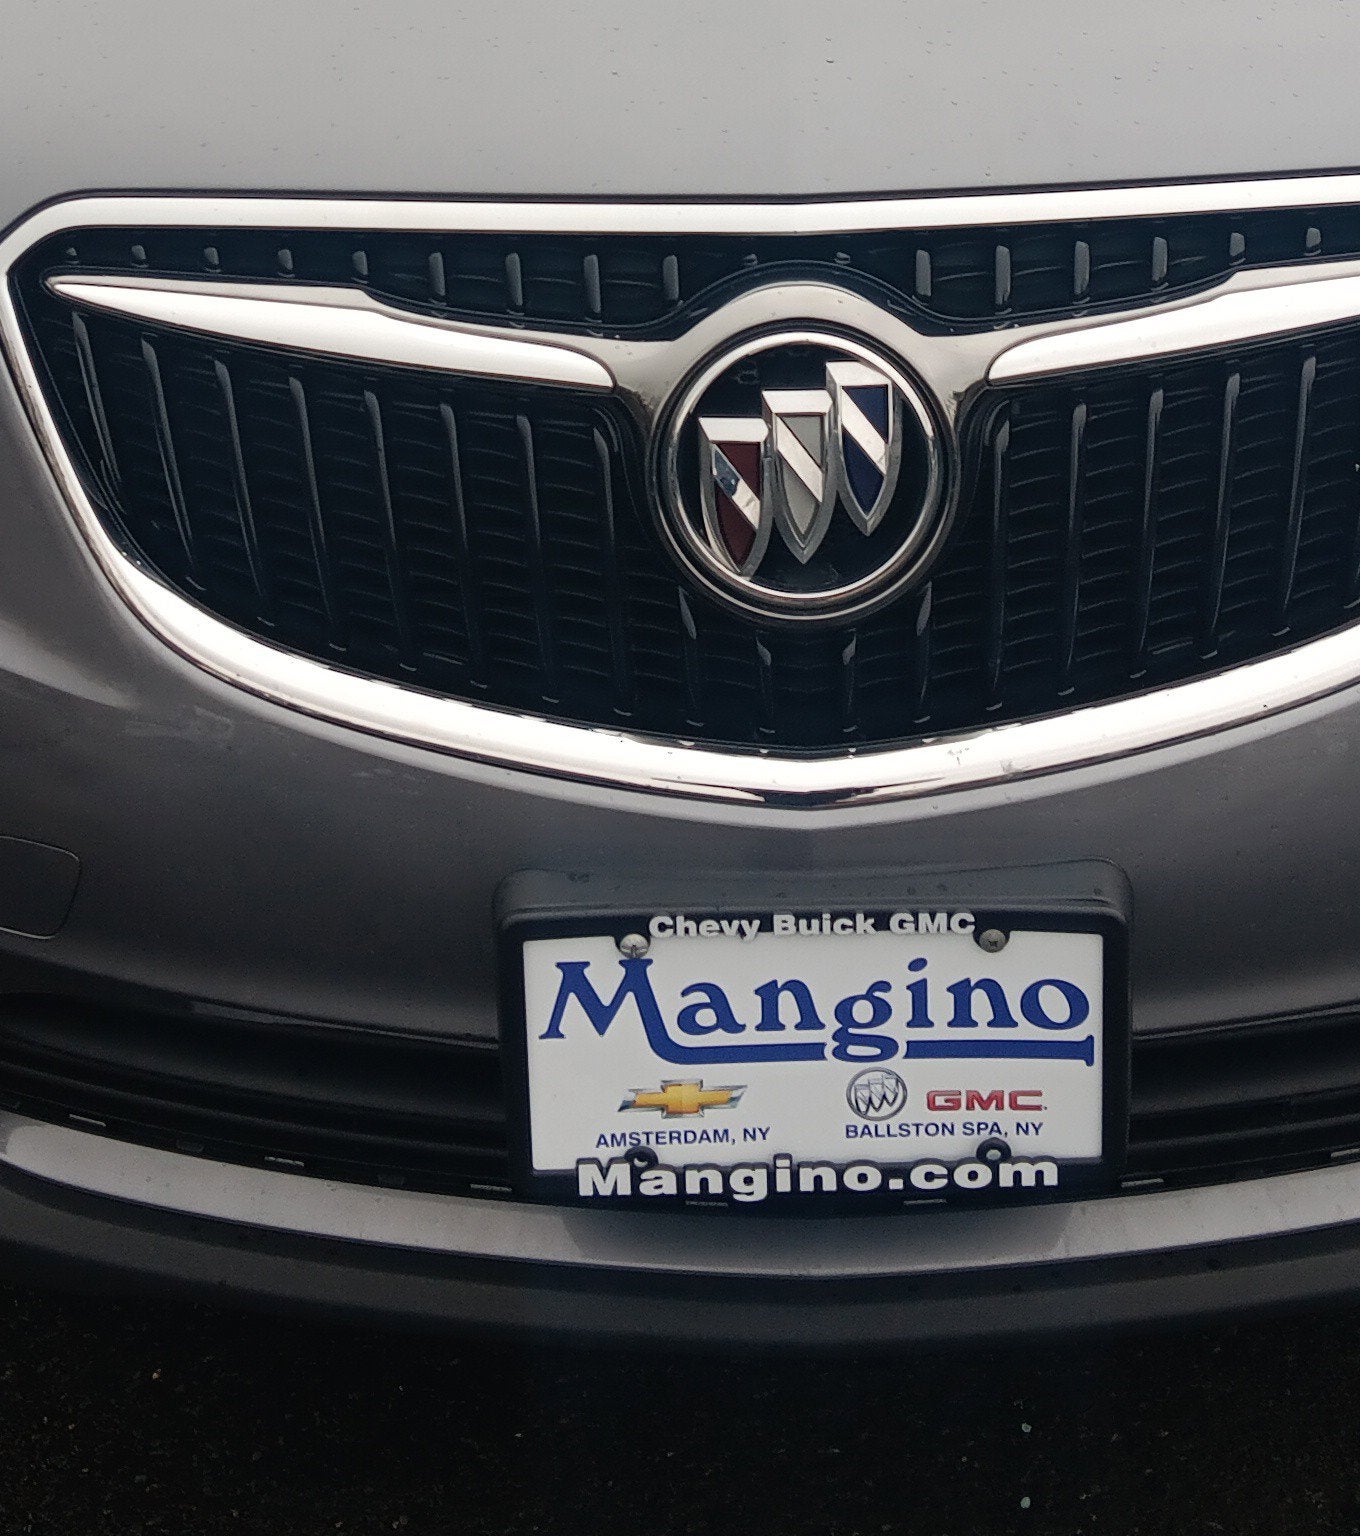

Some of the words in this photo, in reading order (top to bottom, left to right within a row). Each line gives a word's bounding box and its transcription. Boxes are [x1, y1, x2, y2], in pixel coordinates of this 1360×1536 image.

[648, 914, 761, 943] Chevy
[773, 913, 876, 936] Buick
[889, 912, 976, 936] GMC
[539, 958, 1095, 1066] Mangino
[926, 1090, 1044, 1111] GMC
[595, 1128, 737, 1148] AMSTERDAM,
[743, 1126, 771, 1142] NY
[845, 1122, 955, 1139] BALLSTON
[962, 1121, 1009, 1138] SPA,
[1016, 1121, 1044, 1136] NY
[576, 1157, 1059, 1202] Mangino.com
